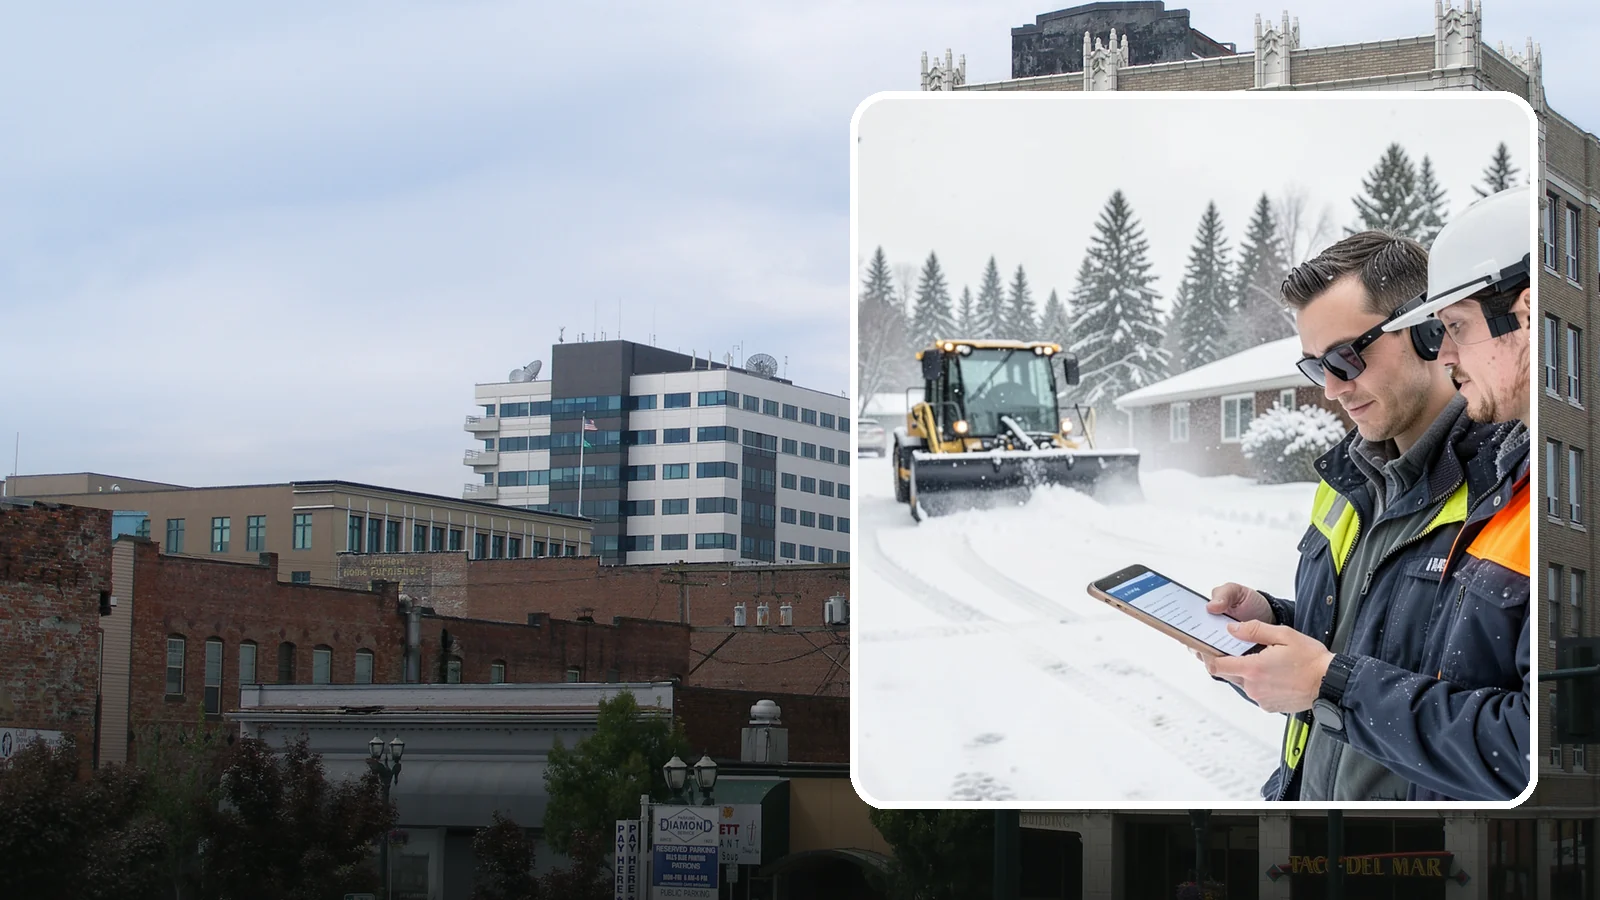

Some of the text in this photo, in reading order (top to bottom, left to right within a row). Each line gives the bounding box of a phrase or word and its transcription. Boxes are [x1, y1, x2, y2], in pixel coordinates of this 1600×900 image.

[370, 566, 427, 577] Furnishers
[660, 818, 713, 833] DIAMOND
[1021, 815, 1070, 828] BUILDING
[616, 824, 625, 894] PAY HERE
[627, 824, 637, 894] PAY HERE
[721, 851, 739, 862] Soup
[671, 862, 701, 870] PATRONS
[1289, 855, 1442, 877] TAC DEL MAR
[660, 888, 711, 898] PUBLIC PARKING
